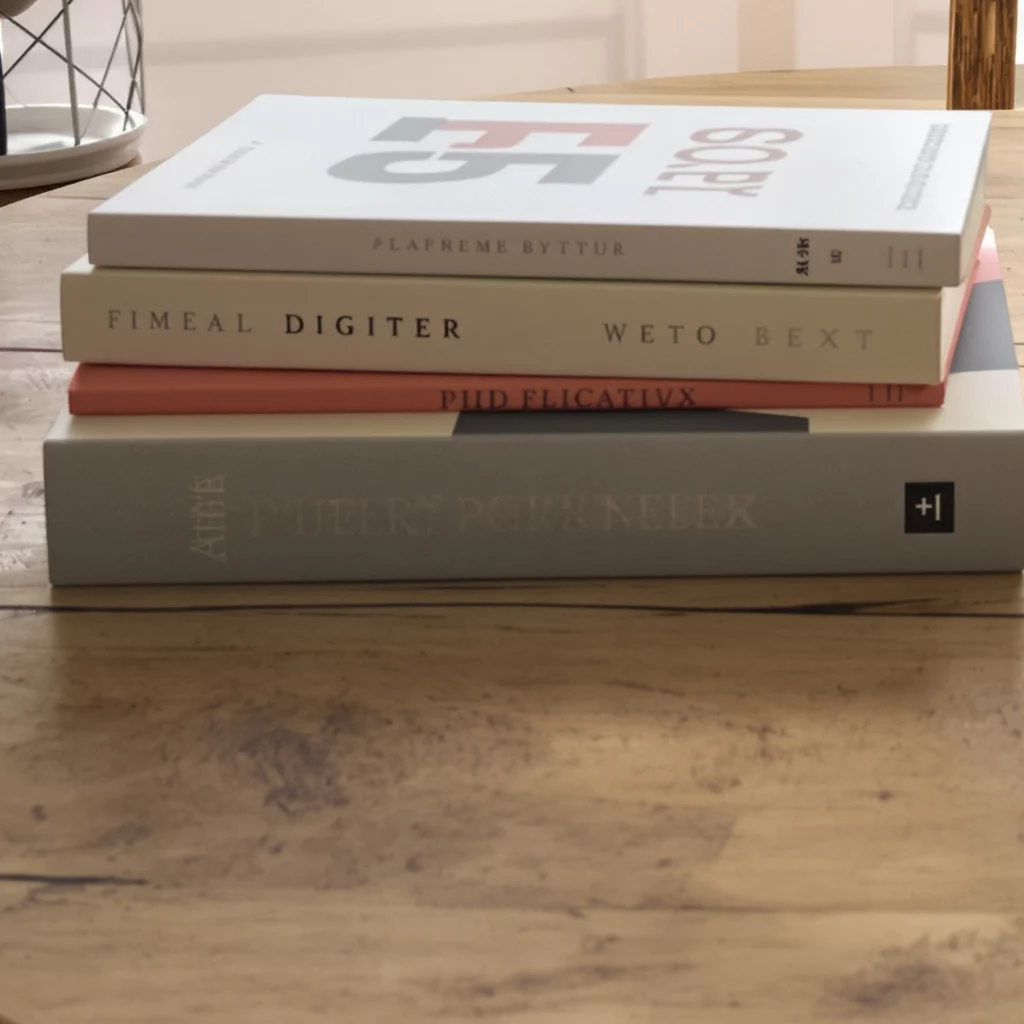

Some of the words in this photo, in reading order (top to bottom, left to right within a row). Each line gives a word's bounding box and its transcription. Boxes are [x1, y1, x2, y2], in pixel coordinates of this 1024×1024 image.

[109, 310, 251, 333] FIMEAL
[285, 314, 460, 338] DIGITER
[603, 323, 717, 345] WETO
[755, 327, 873, 350] BEXT
